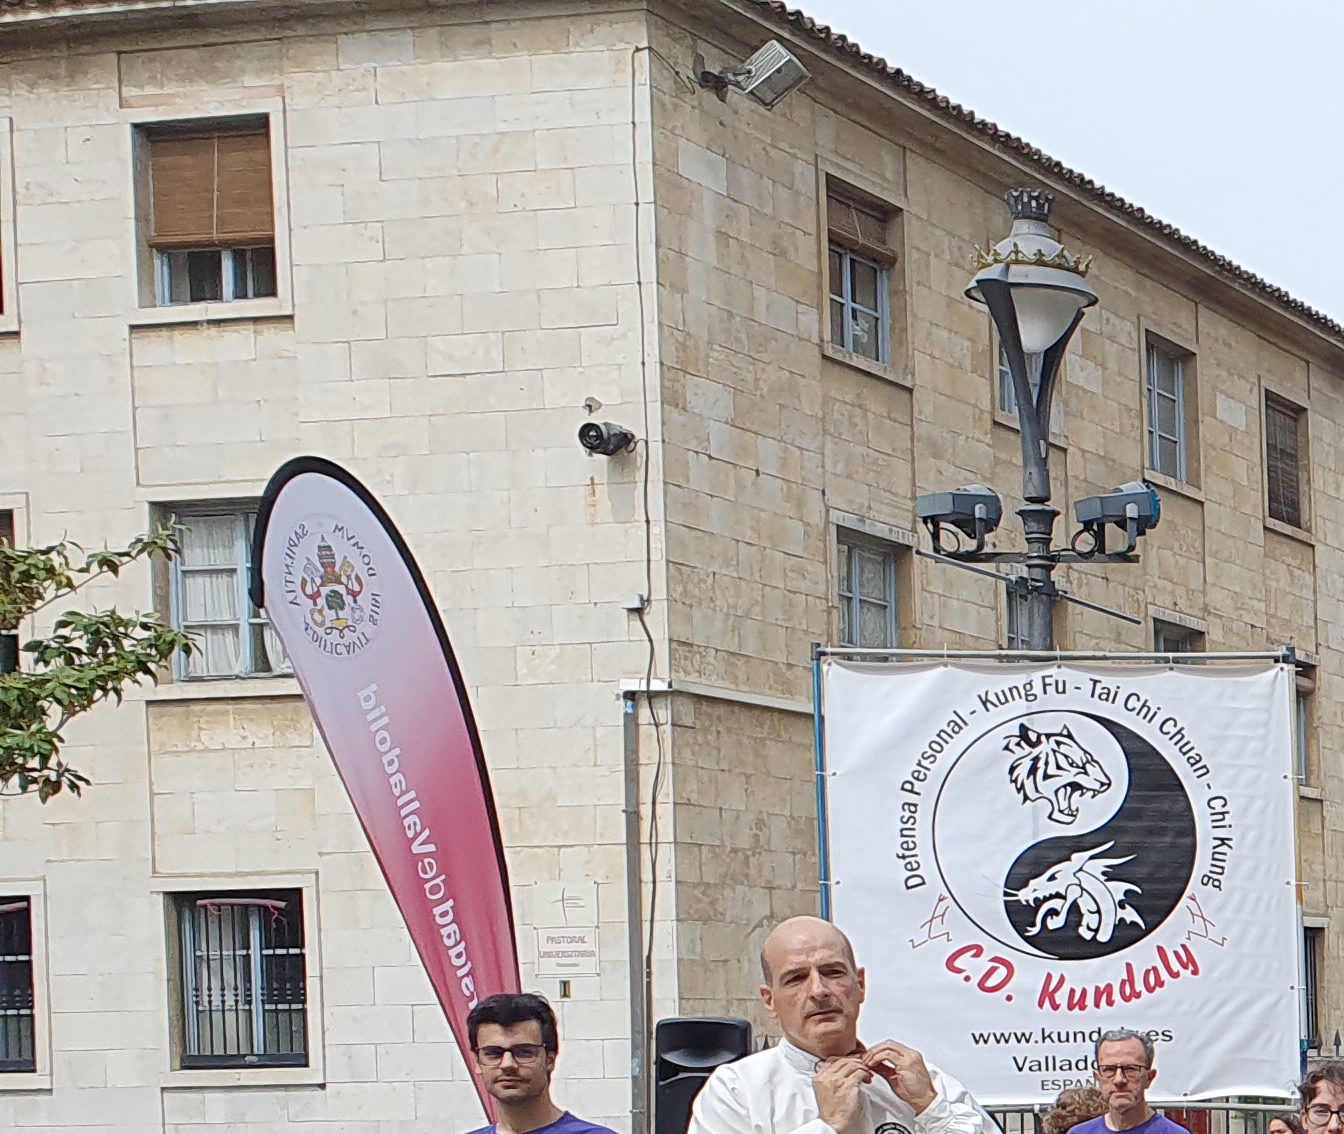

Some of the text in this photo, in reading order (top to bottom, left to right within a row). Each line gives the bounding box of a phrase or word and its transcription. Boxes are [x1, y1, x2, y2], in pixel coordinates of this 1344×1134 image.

[976, 678, 1038, 713] Kung
[1041, 674, 1067, 696] Fu
[1088, 677, 1121, 705] Tai
[1123, 692, 1162, 724] Chi
[899, 709, 970, 797] Personal
[1158, 716, 1211, 780] Chuan
[1206, 795, 1233, 830] Chi
[895, 801, 927, 891] Defensa
[1200, 835, 1234, 892] Kung
[546, 935, 588, 945] PASTORAL
[945, 943, 1200, 1012] C.D. Kundaly
[1040, 1075, 1097, 1091] ESPAÑ
